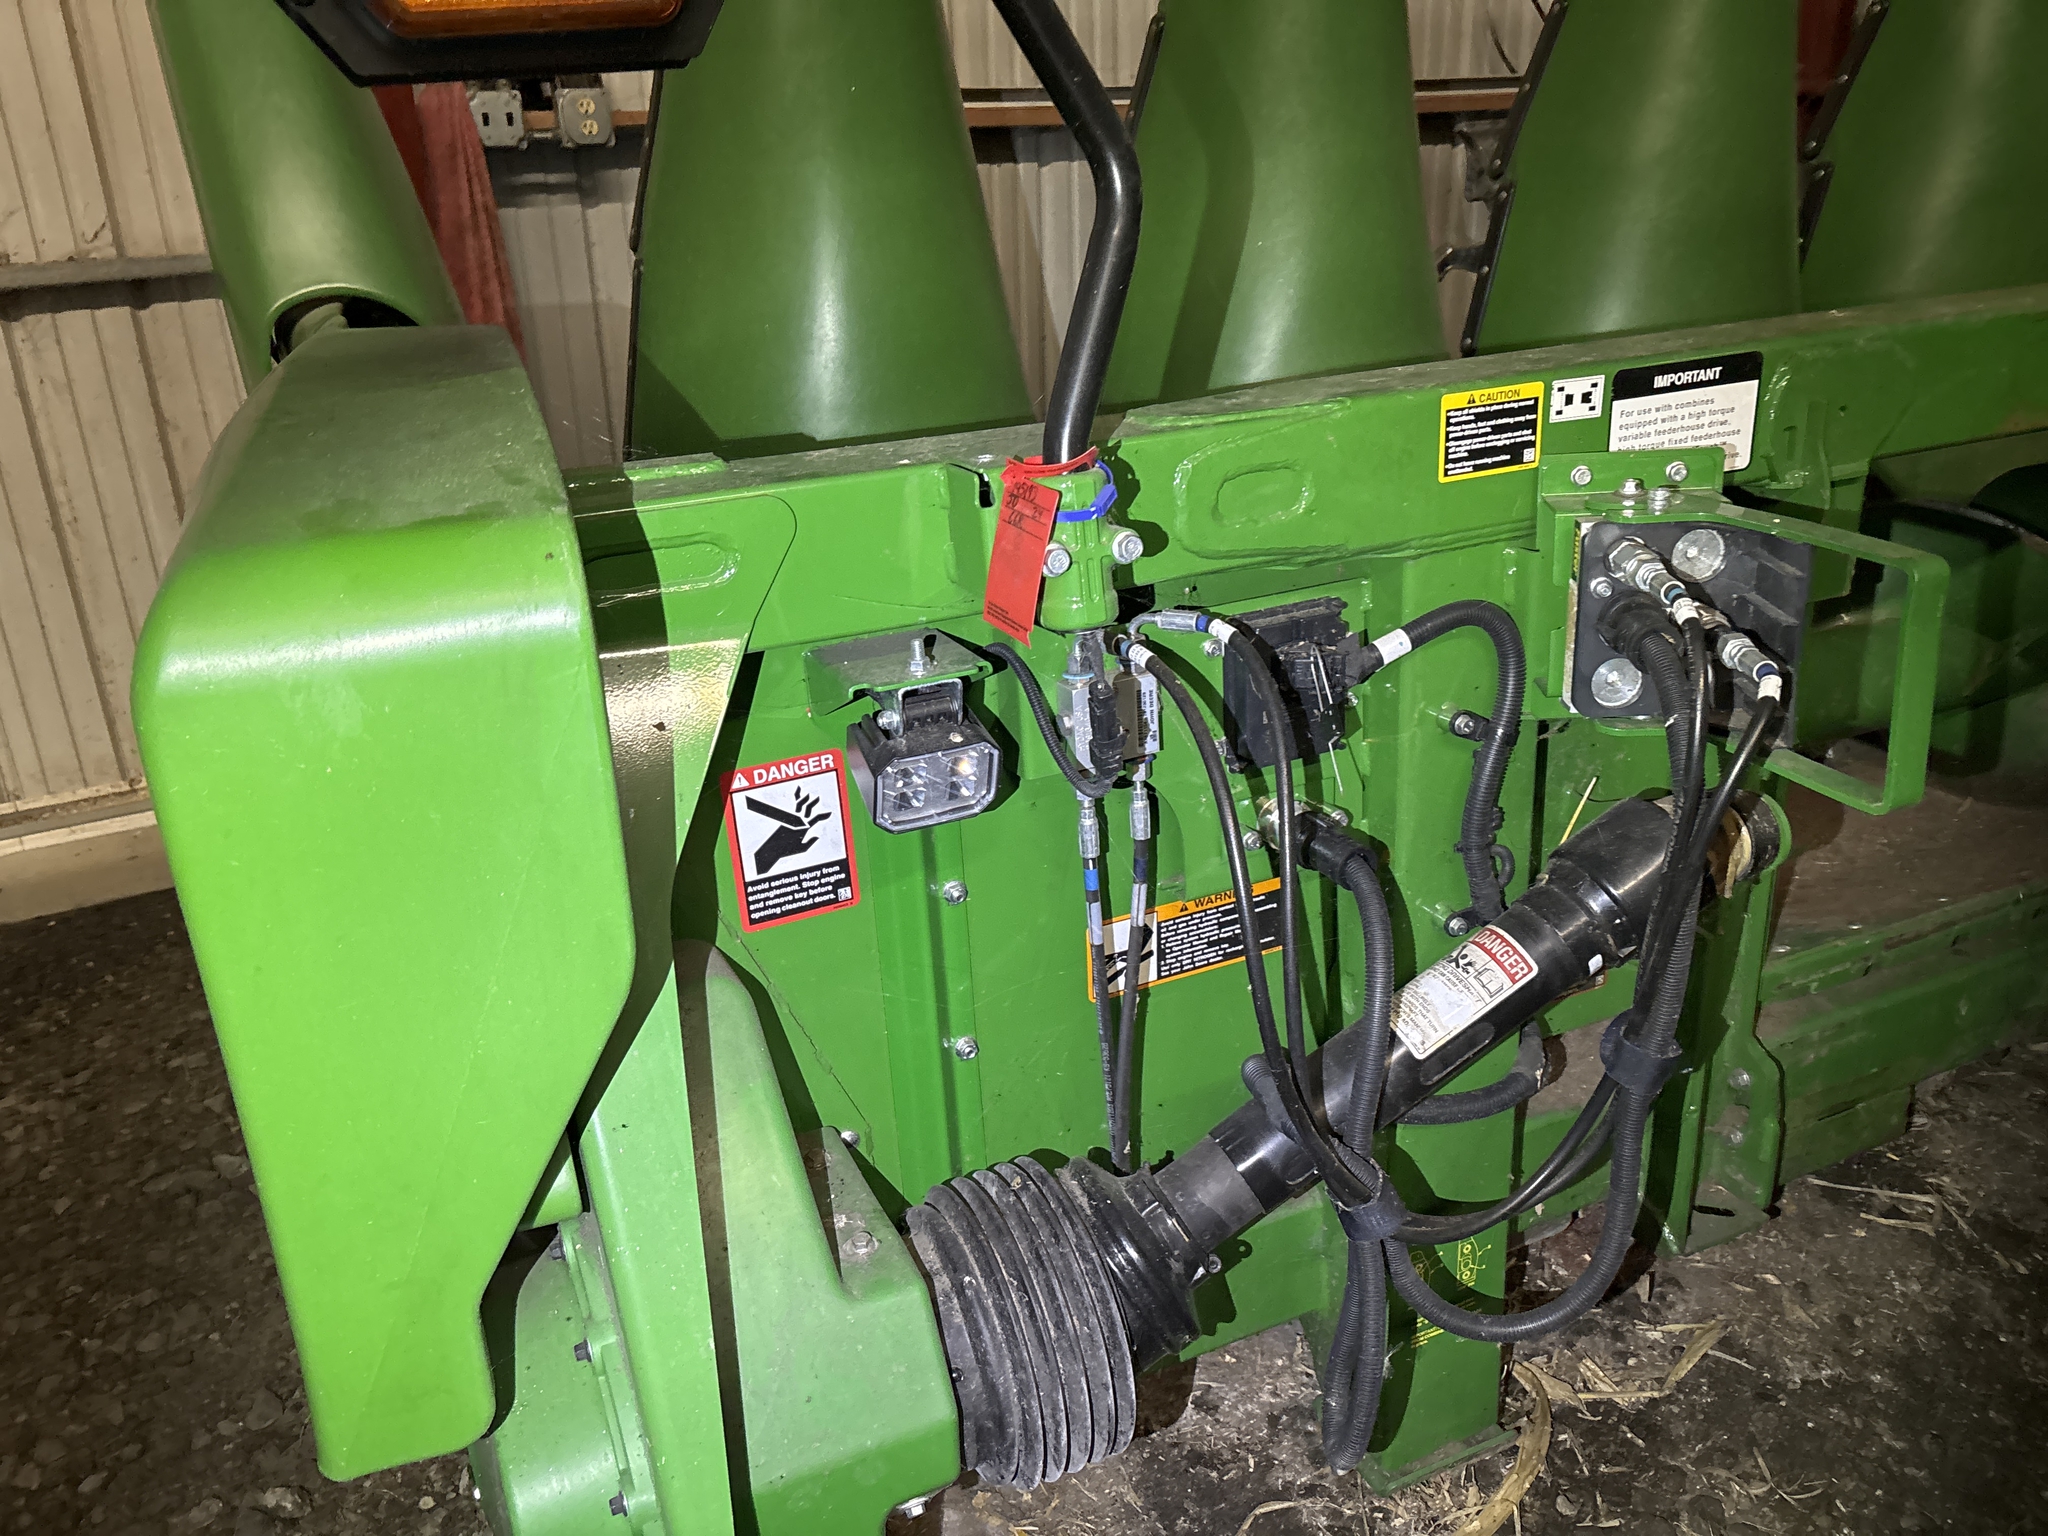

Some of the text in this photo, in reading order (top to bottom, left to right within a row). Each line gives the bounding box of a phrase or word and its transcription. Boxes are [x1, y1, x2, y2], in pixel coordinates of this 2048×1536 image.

[1654, 367, 1722, 388] IMPORTANT
[1479, 389, 1520, 402] CAUTION
[1620, 397, 1714, 418] For use with combines
[1619, 417, 1658, 431] equipped
[1661, 414, 1678, 424] with
[1688, 410, 1706, 421] high
[1709, 406, 1735, 416] torque
[1618, 431, 1651, 443] variable
[1654, 422, 1705, 436] feederhouse
[1638, 440, 1665, 450] torque
[1668, 436, 1688, 446] fixed
[1691, 428, 1741, 442] feederhouse
[753, 754, 834, 785] DANGER
[747, 865, 840, 893] Avoid serious injury from
[748, 872, 845, 902] entanglement. Stop engine
[749, 885, 832, 911] and remove key before
[750, 893, 836, 919] opening cleanout doors.
[1475, 930, 1528, 981] DANGER
